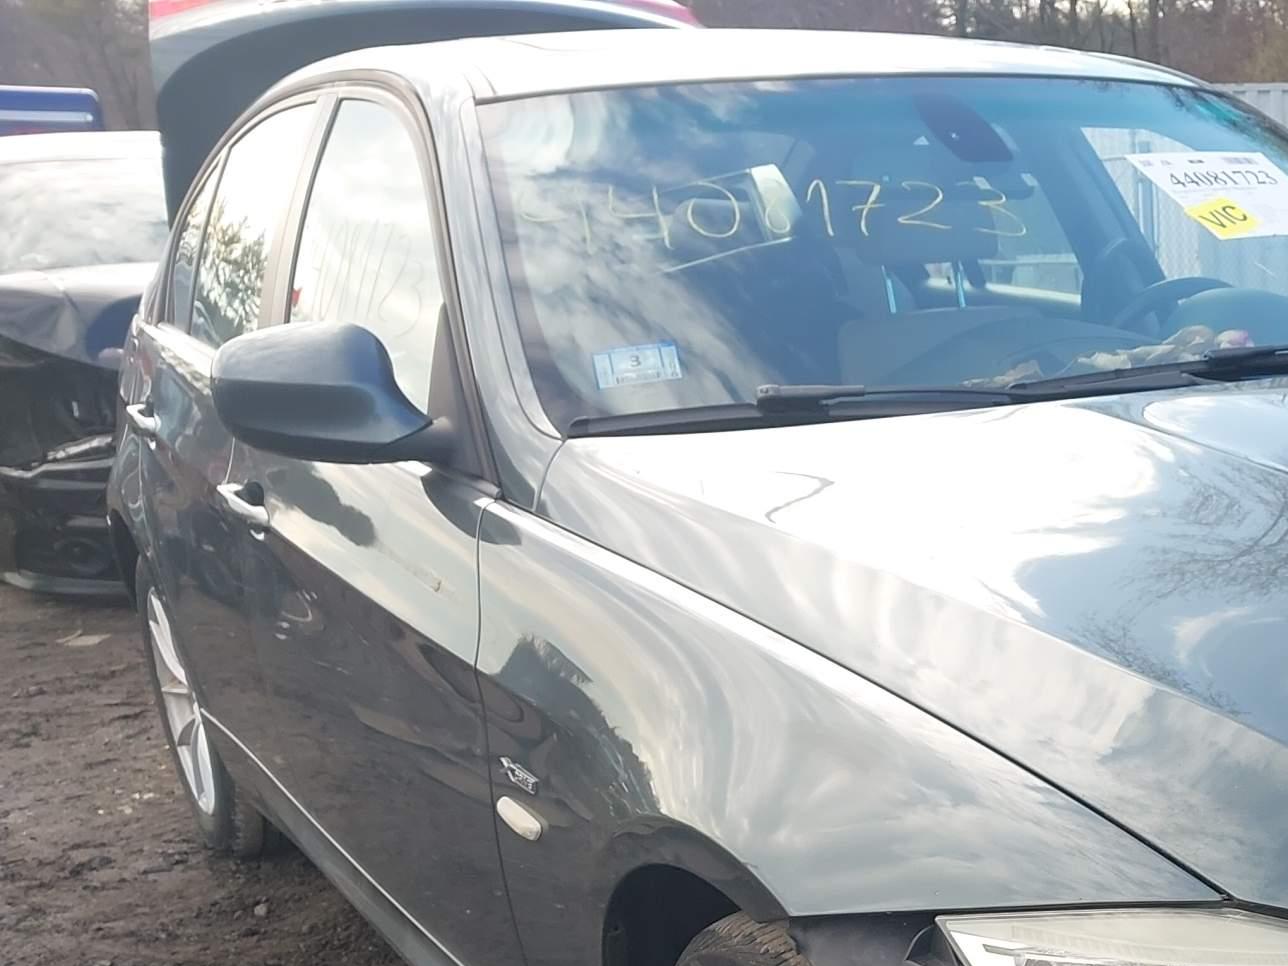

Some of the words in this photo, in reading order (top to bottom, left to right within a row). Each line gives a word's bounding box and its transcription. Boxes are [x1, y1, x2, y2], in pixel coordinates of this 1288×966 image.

[1170, 169, 1279, 188] 44081723
[516, 177, 1028, 256] 44081723
[1199, 205, 1248, 229] VIC
